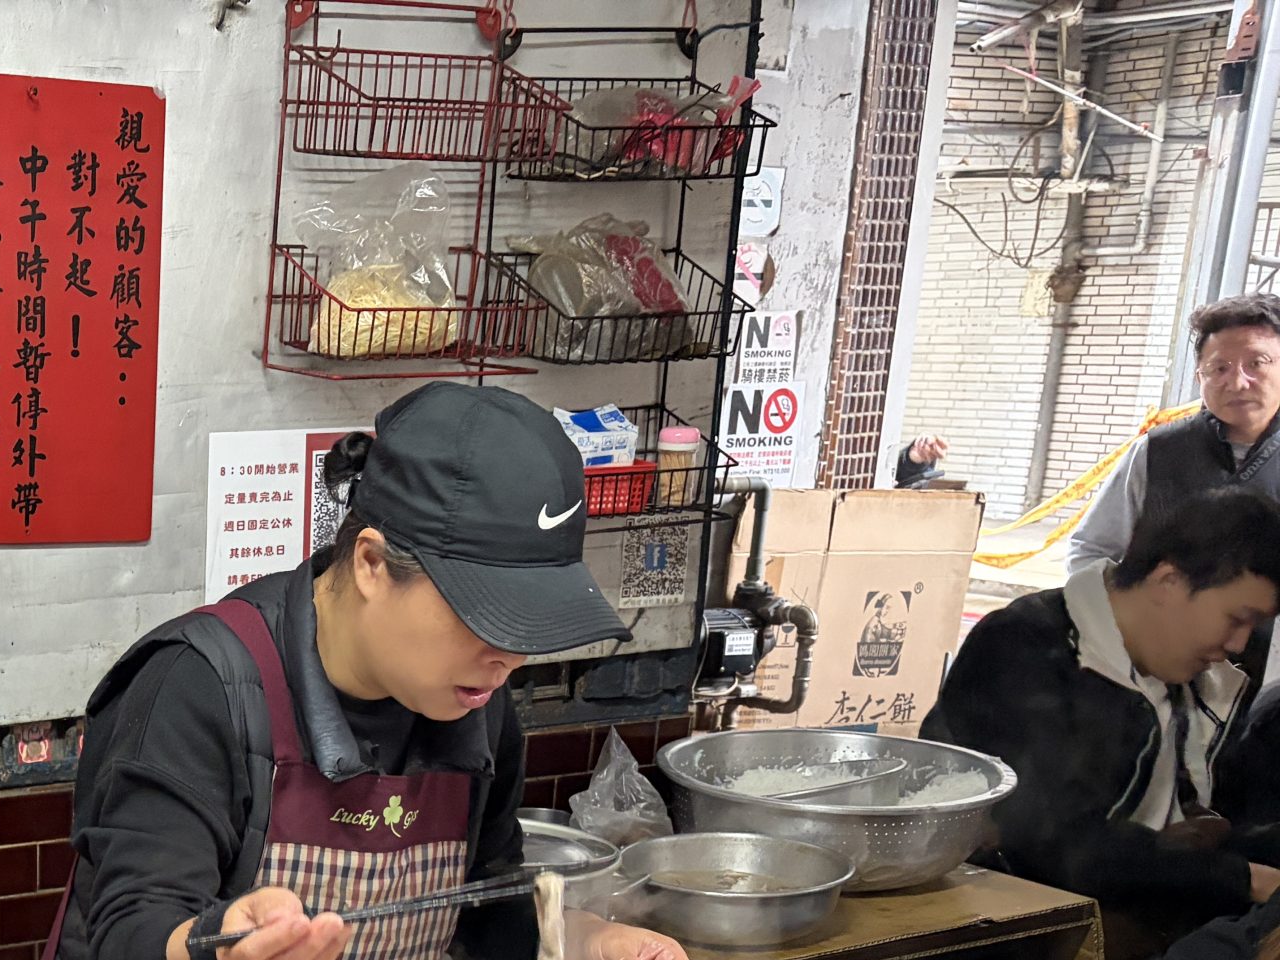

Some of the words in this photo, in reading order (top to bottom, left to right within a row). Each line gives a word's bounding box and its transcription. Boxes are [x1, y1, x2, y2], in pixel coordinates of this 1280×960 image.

[743, 350, 792, 358] SMOKING
[725, 435, 794, 448] SMOKING
[824, 690, 917, 724] 杏仁餅
[330, 808, 380, 831] Lucky
